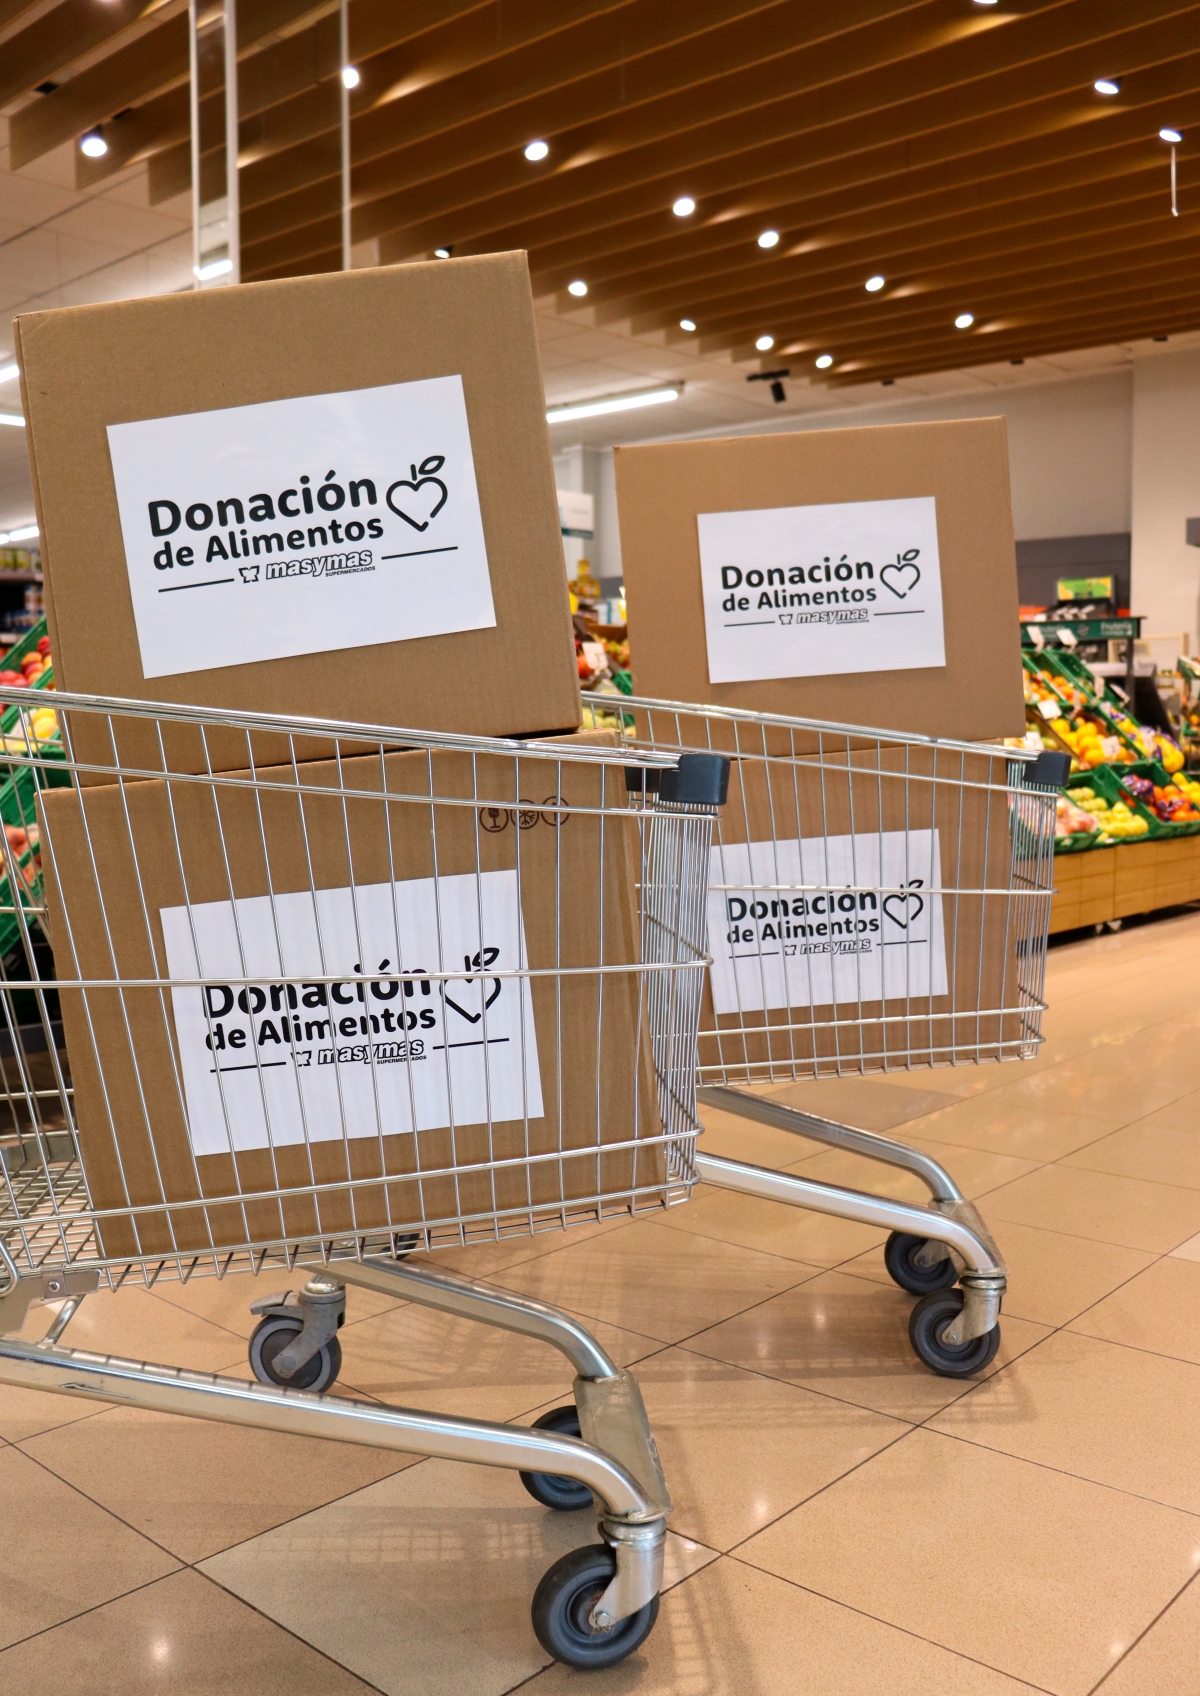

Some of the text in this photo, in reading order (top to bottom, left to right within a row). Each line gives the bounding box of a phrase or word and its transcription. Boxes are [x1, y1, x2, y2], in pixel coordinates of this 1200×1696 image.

[148, 470, 378, 538] Donación
[153, 518, 384, 570] de Alimentos
[266, 550, 373, 580] masymas
[325, 566, 376, 577] SUPERMERCADOS
[721, 554, 874, 590] Donación
[722, 587, 877, 613] de Alimentos
[796, 608, 869, 625] masymas
[727, 917, 880, 944] de Alimentos
[800, 938, 871, 955] masymas
[204, 958, 431, 1019] Donación
[205, 1008, 436, 1051] de Alimentos
[318, 1039, 424, 1065] masymas
[376, 1055, 427, 1064] SUPERMERADOS
